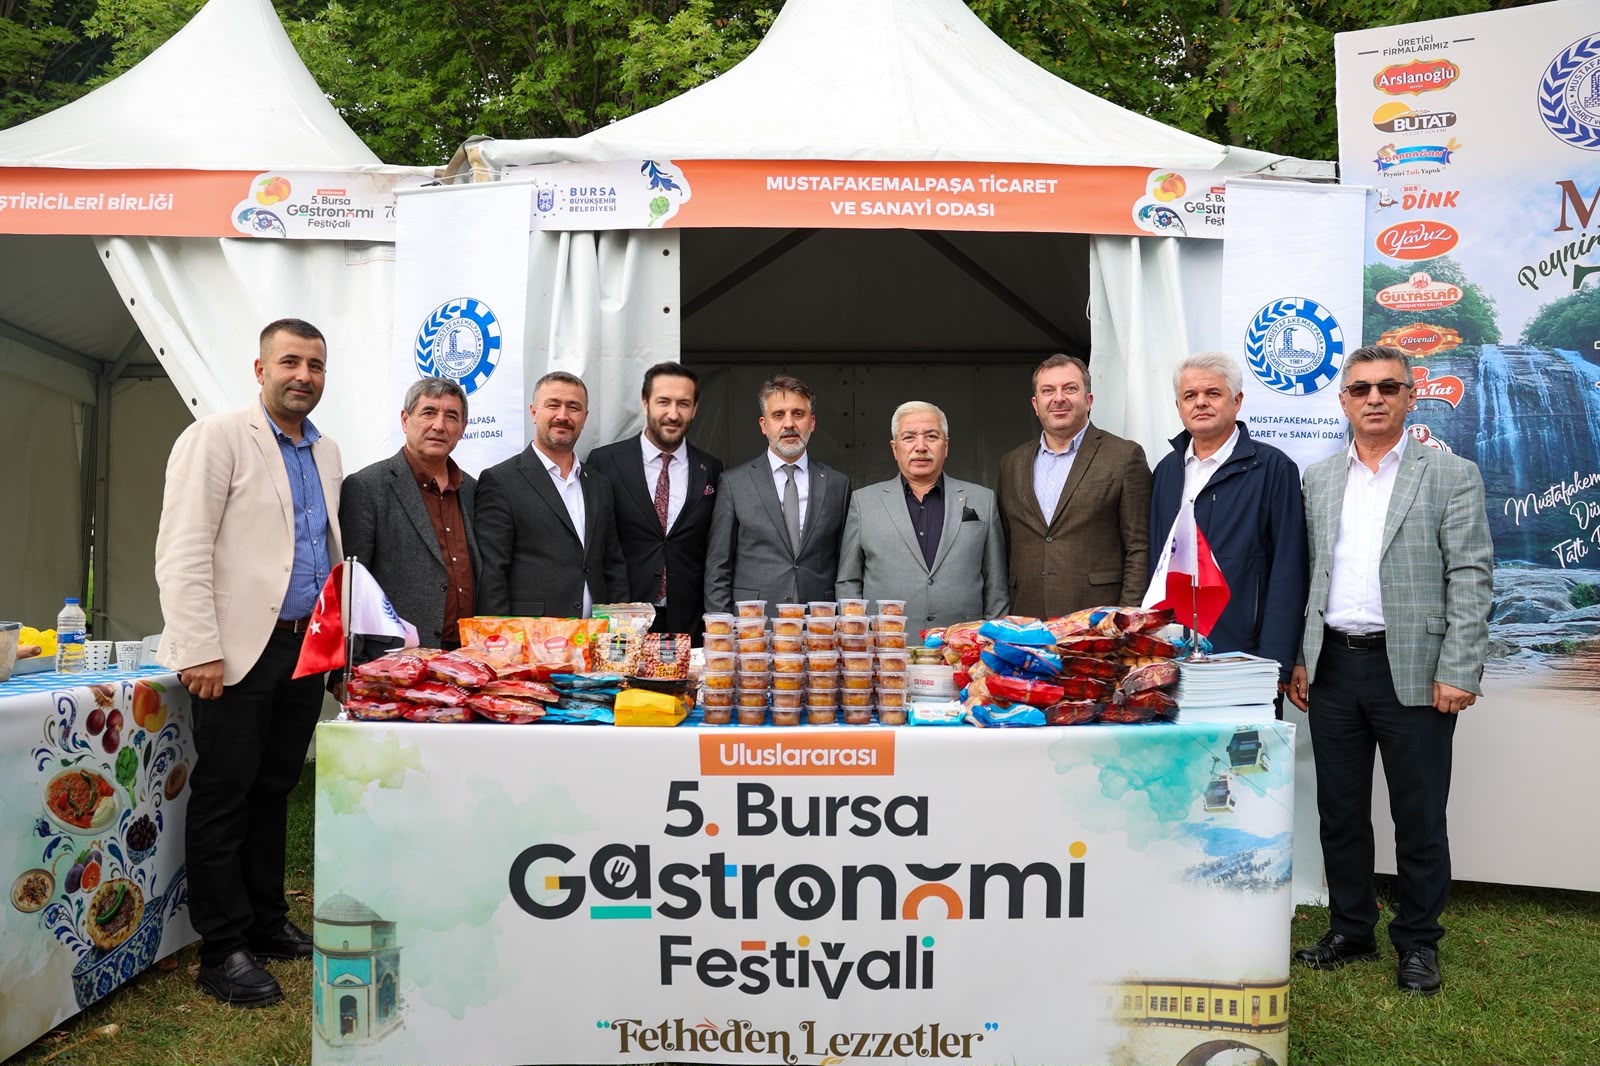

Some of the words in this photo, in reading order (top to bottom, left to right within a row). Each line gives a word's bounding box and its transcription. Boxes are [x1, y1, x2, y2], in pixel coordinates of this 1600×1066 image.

[1383, 41, 1449, 56] FİRMALARIMIZ
[1398, 34, 1434, 47] ÜRETİCİ
[1393, 113, 1450, 132] BUTAT
[569, 187, 617, 197] BURSA
[766, 176, 975, 195] MUSTAFAKEMALPAŞA
[979, 174, 1058, 194] TİCARET
[107, 193, 174, 211] BİRLİĞİ
[321, 196, 351, 206] Bursa
[569, 196, 617, 206] BÜYÜKŞEHİR
[569, 204, 617, 212] BELEDİYESİ
[830, 201, 857, 216] VE
[860, 198, 932, 216] SANAYİ
[935, 202, 995, 217] ODASI
[1402, 189, 1460, 211] DİNK
[286, 203, 374, 219] Gastronomi
[307, 218, 351, 229] Festivali
[1384, 223, 1453, 257] Yavuz
[1267, 317, 1324, 345] MUSTAFAKEMALPAŞA
[1400, 334, 1438, 346] Güvenal
[1249, 416, 1340, 425] MUSTAFAKEMALPAŞA
[480, 430, 503, 438] ODASI
[1249, 430, 1277, 438] CARET
[1289, 430, 1320, 439] SANAYİ
[719, 742, 877, 766] Uluslararası
[663, 780, 720, 837] 5.
[736, 782, 929, 837] Bursa
[508, 840, 1087, 921] Gastronomi
[659, 934, 935, 1000] Festivali
